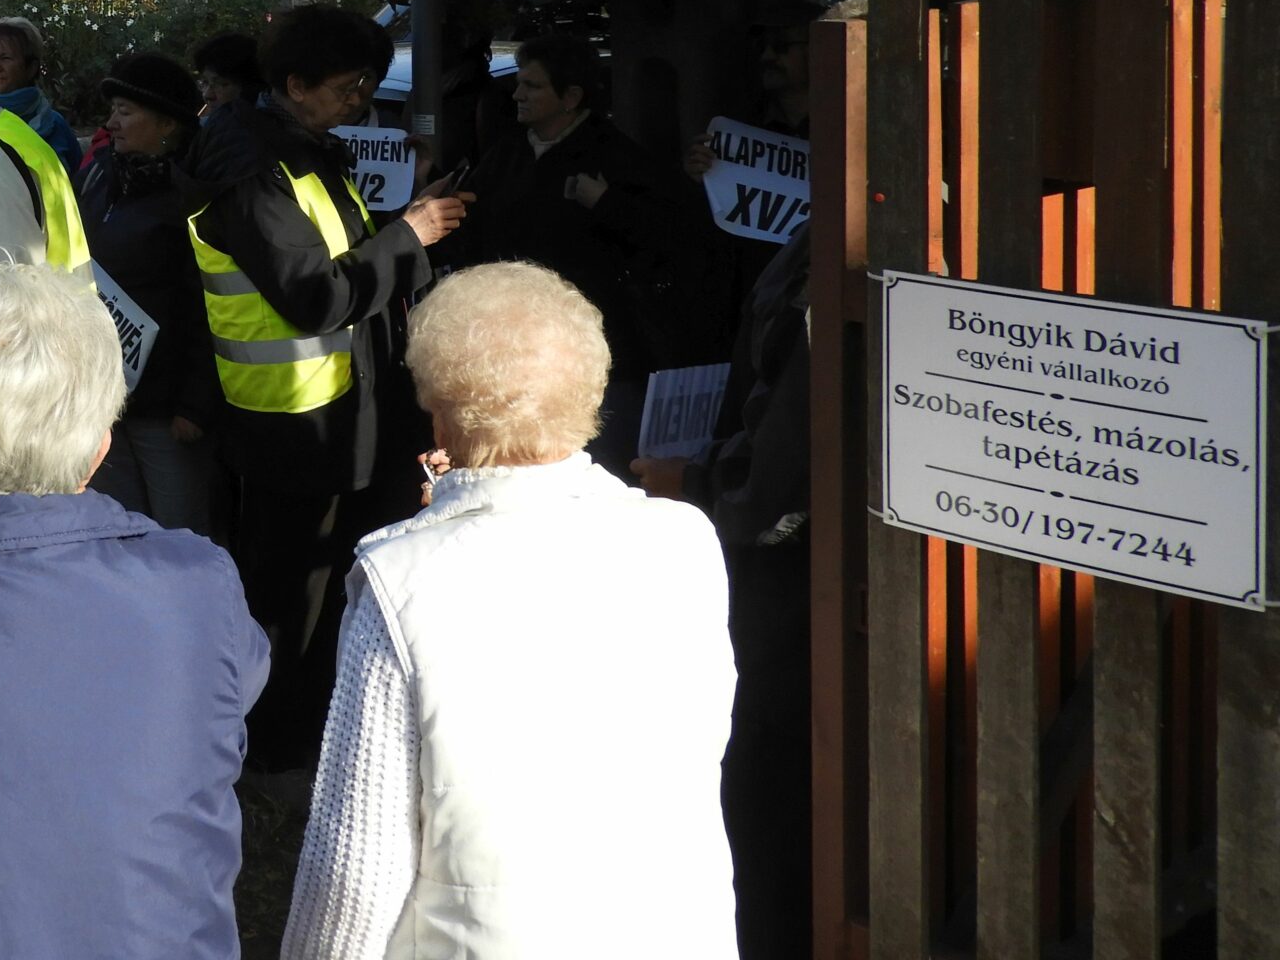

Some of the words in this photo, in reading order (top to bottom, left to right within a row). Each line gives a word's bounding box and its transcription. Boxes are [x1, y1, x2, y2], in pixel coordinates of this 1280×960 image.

[709, 130, 810, 181] ALAPTÖR
[947, 308, 1074, 349] Böngyik
[1083, 329, 1181, 365] Dávid
[956, 347, 1034, 374] egyéni
[1040, 360, 1171, 396] vállalkozó
[893, 383, 1082, 443] Szobafestés,
[1093, 424, 1252, 472] mázolás,
[982, 436, 1141, 487] tapétázás
